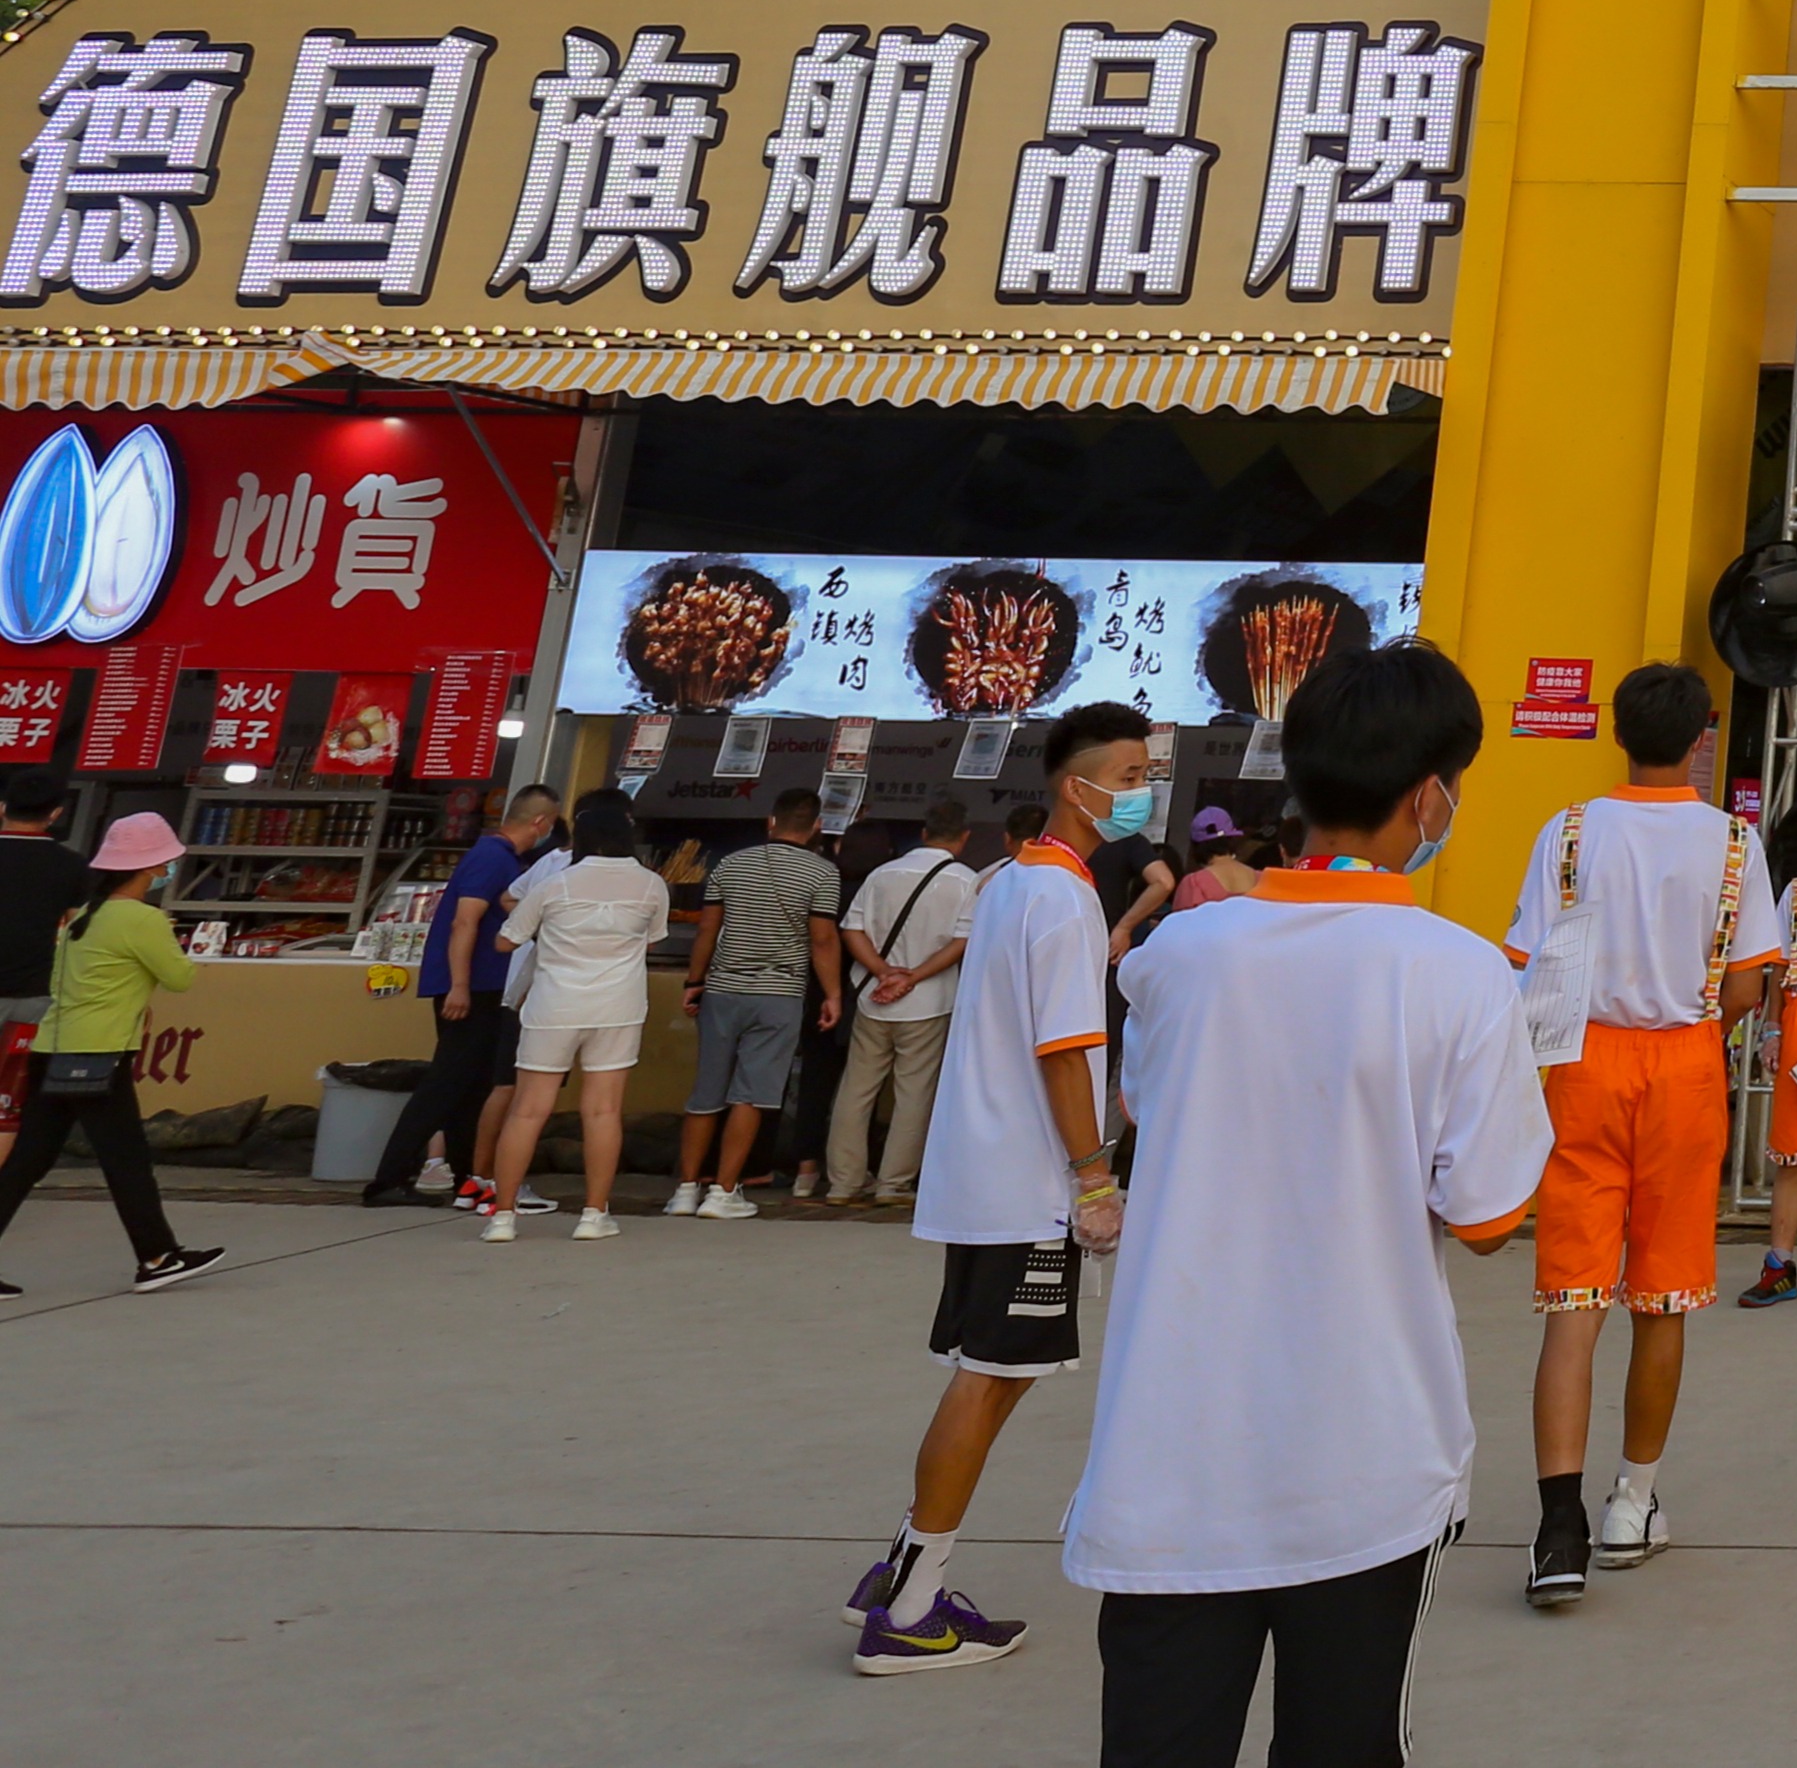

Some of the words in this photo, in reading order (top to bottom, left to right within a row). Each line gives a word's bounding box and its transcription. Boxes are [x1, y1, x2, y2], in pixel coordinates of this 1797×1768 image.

[2, 29, 1481, 301] 德国旗舰品牌
[203, 473, 448, 609] 炒貨
[0, 679, 62, 710] 冰火
[218, 681, 282, 712] 冰火
[209, 718, 270, 750] 栗子
[667, 782, 736, 799] Jetstar
